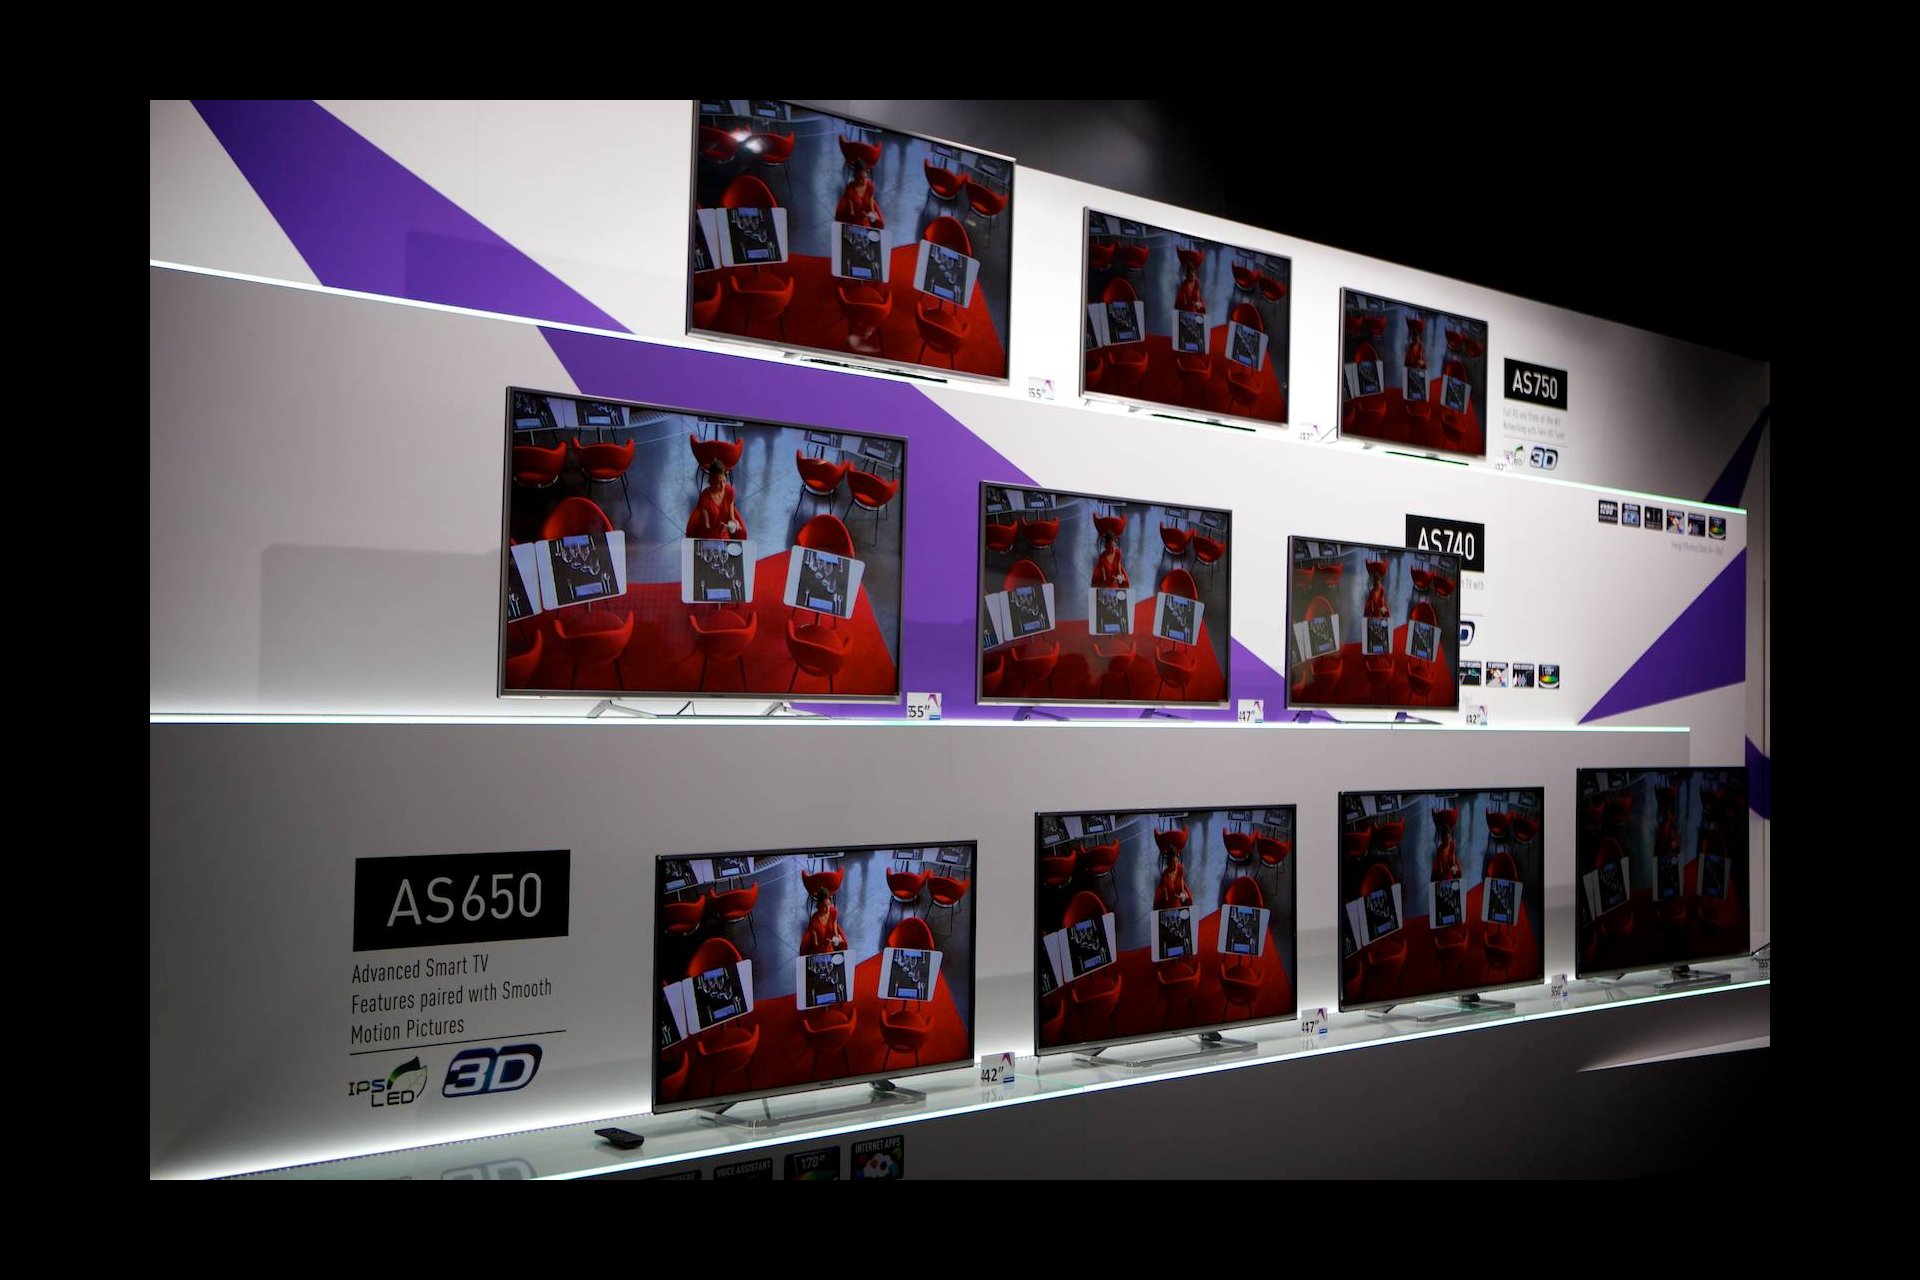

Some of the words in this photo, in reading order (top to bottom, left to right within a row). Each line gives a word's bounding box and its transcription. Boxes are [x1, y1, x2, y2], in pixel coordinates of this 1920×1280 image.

[1512, 368, 1558, 400] AS750
[1530, 446, 1558, 471] 3D
[1417, 527, 1475, 560] AS740
[386, 872, 543, 928] AS650
[351, 959, 421, 984] Advanced
[426, 956, 468, 978] Smart
[472, 953, 489, 974] TV
[351, 993, 415, 1014] Features
[420, 984, 463, 1013] paired
[468, 983, 497, 1003] with
[502, 977, 552, 1001] Smooth
[351, 1021, 400, 1045] Motion
[406, 1018, 465, 1039] Pictures
[442, 1043, 543, 1098] 3D
[348, 1078, 386, 1097] IPS
[371, 1089, 416, 1108] LED
[854, 1140, 884, 1155] INTERNET
[884, 1136, 902, 1149] APPS
[736, 1161, 773, 1176] ASSISTANT
